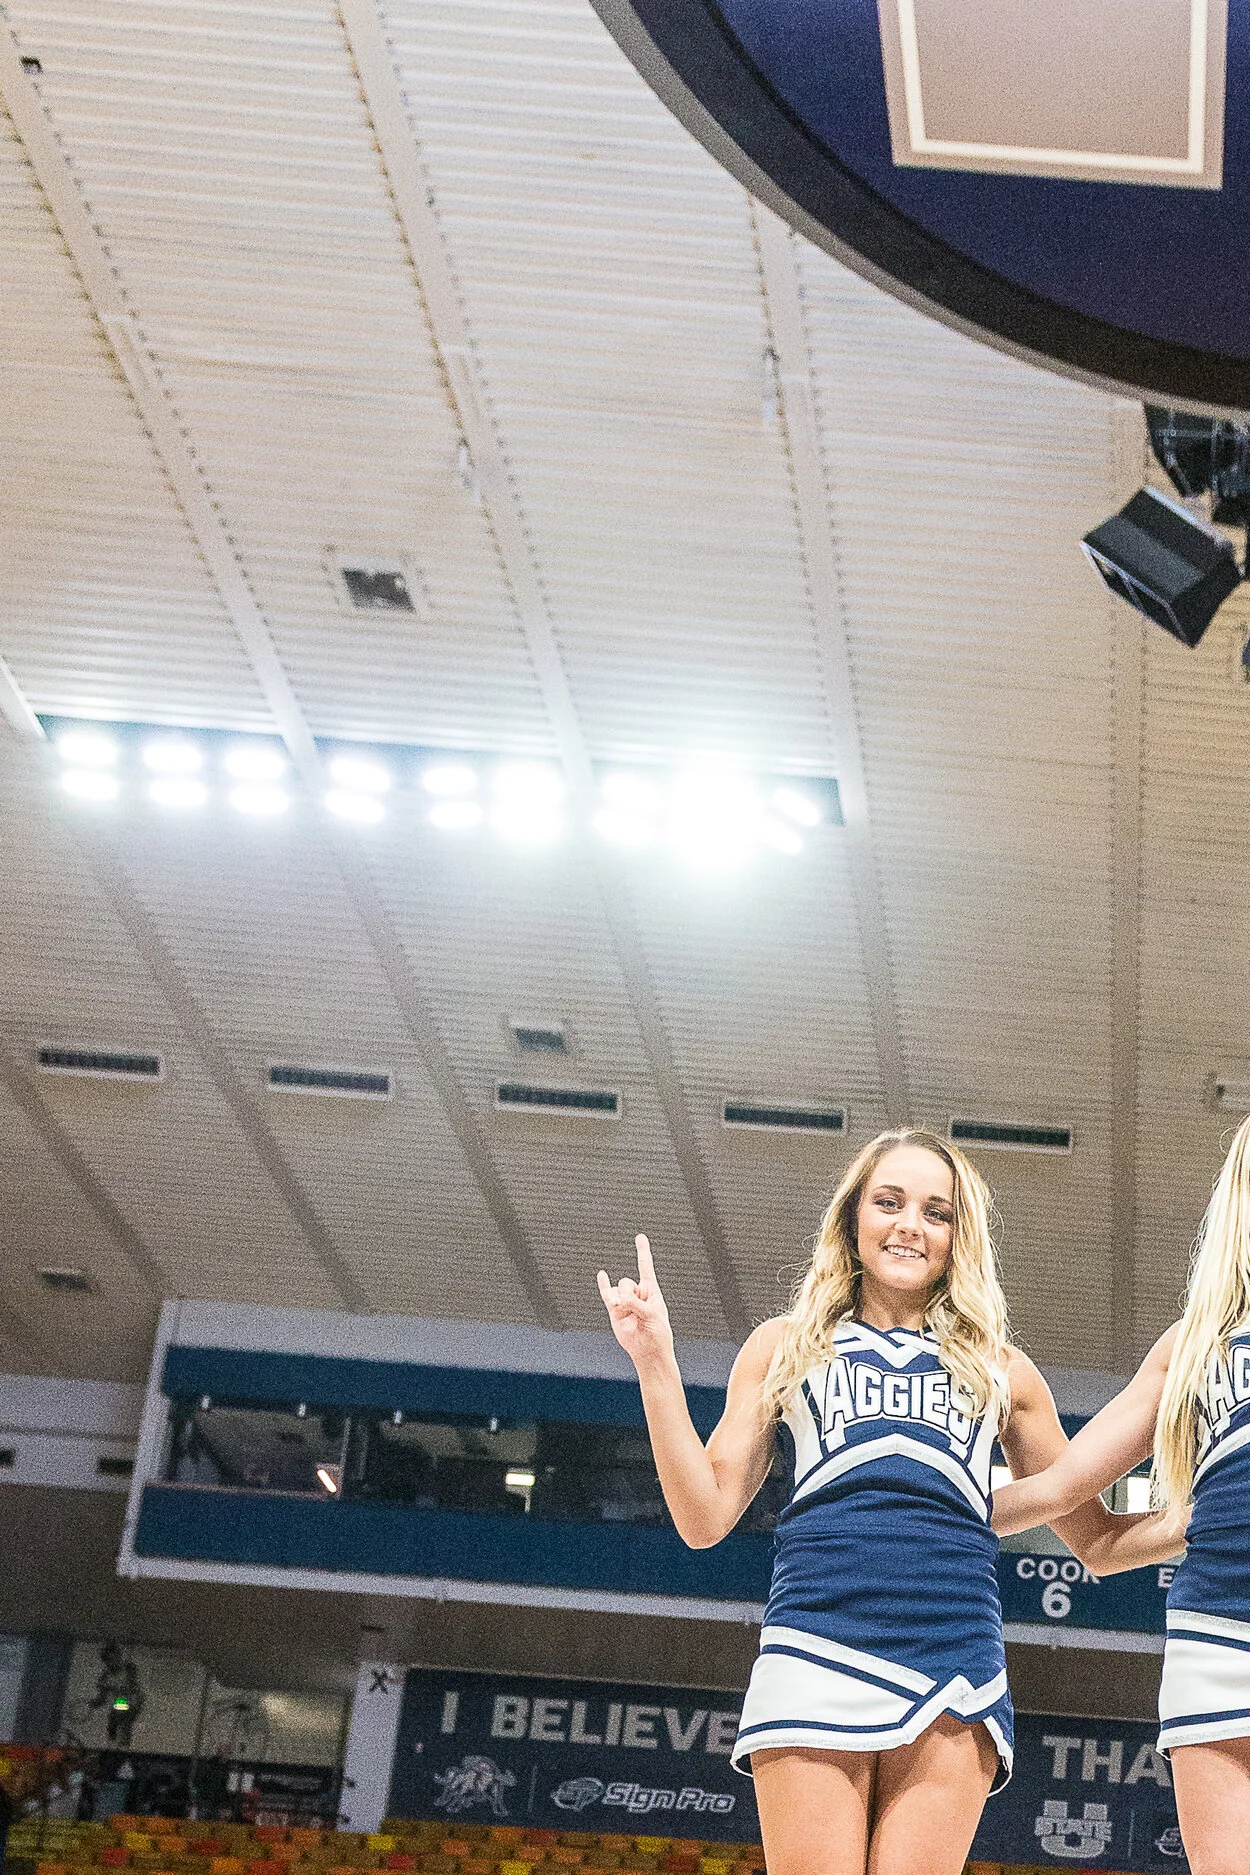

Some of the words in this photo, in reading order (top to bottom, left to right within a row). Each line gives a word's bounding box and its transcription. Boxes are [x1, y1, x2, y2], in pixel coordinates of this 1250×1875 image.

[822, 1356, 978, 1445] AGGIES
[1041, 1581, 1071, 1618] 6
[368, 1669, 389, 1694] X
[441, 1691, 458, 1734] I
[491, 1694, 741, 1753] BELIEVE
[602, 1782, 676, 1814] Sign
[674, 1787, 736, 1814] Pro
